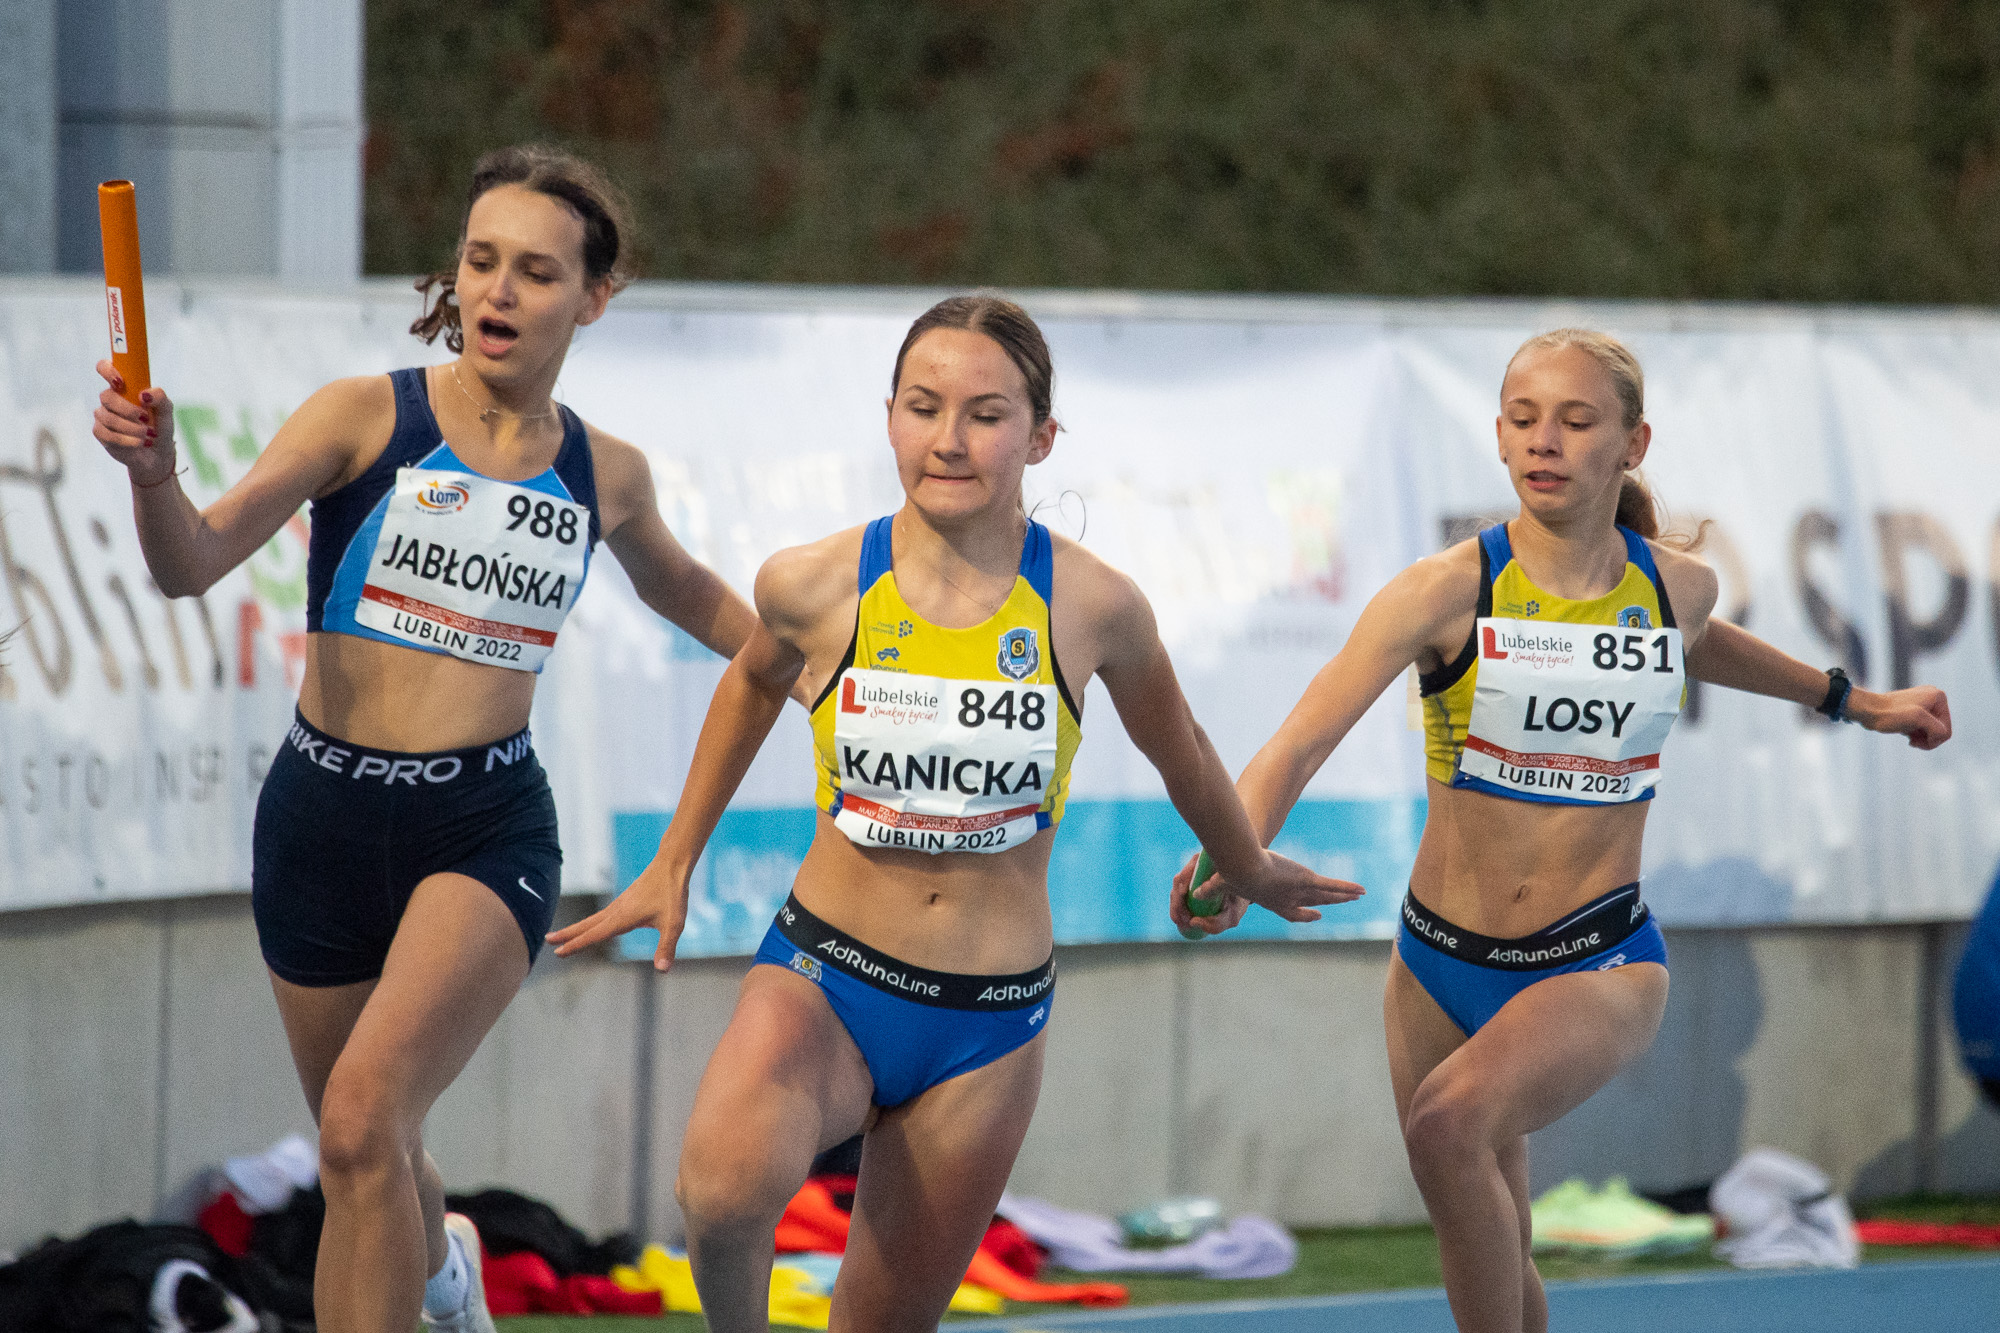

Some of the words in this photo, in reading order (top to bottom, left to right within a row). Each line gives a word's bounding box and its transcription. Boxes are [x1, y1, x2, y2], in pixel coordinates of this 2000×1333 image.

[109, 291, 123, 334] polanik
[505, 494, 578, 546] 988
[381, 533, 567, 610] JABŁOŃSKA
[393, 612, 469, 650] LUBLIN
[473, 638, 522, 661] 2022
[1592, 633, 1674, 673] 851
[1512, 651, 1544, 670] Smakuj
[870, 705, 907, 725] Smakuj
[957, 688, 1046, 731] 848
[1523, 695, 1636, 738] LOSY
[352, 755, 463, 786] PRO
[485, 729, 532, 773] NIK
[843, 745, 1042, 796] KANICKA
[1497, 762, 1574, 791] LUBLIN
[1580, 774, 1631, 795] 2022
[866, 822, 945, 850] LUBLIN
[953, 827, 1007, 850] 2022
[817, 940, 941, 997] AdRunaLine
[1487, 932, 1601, 963] AdRunaLine
